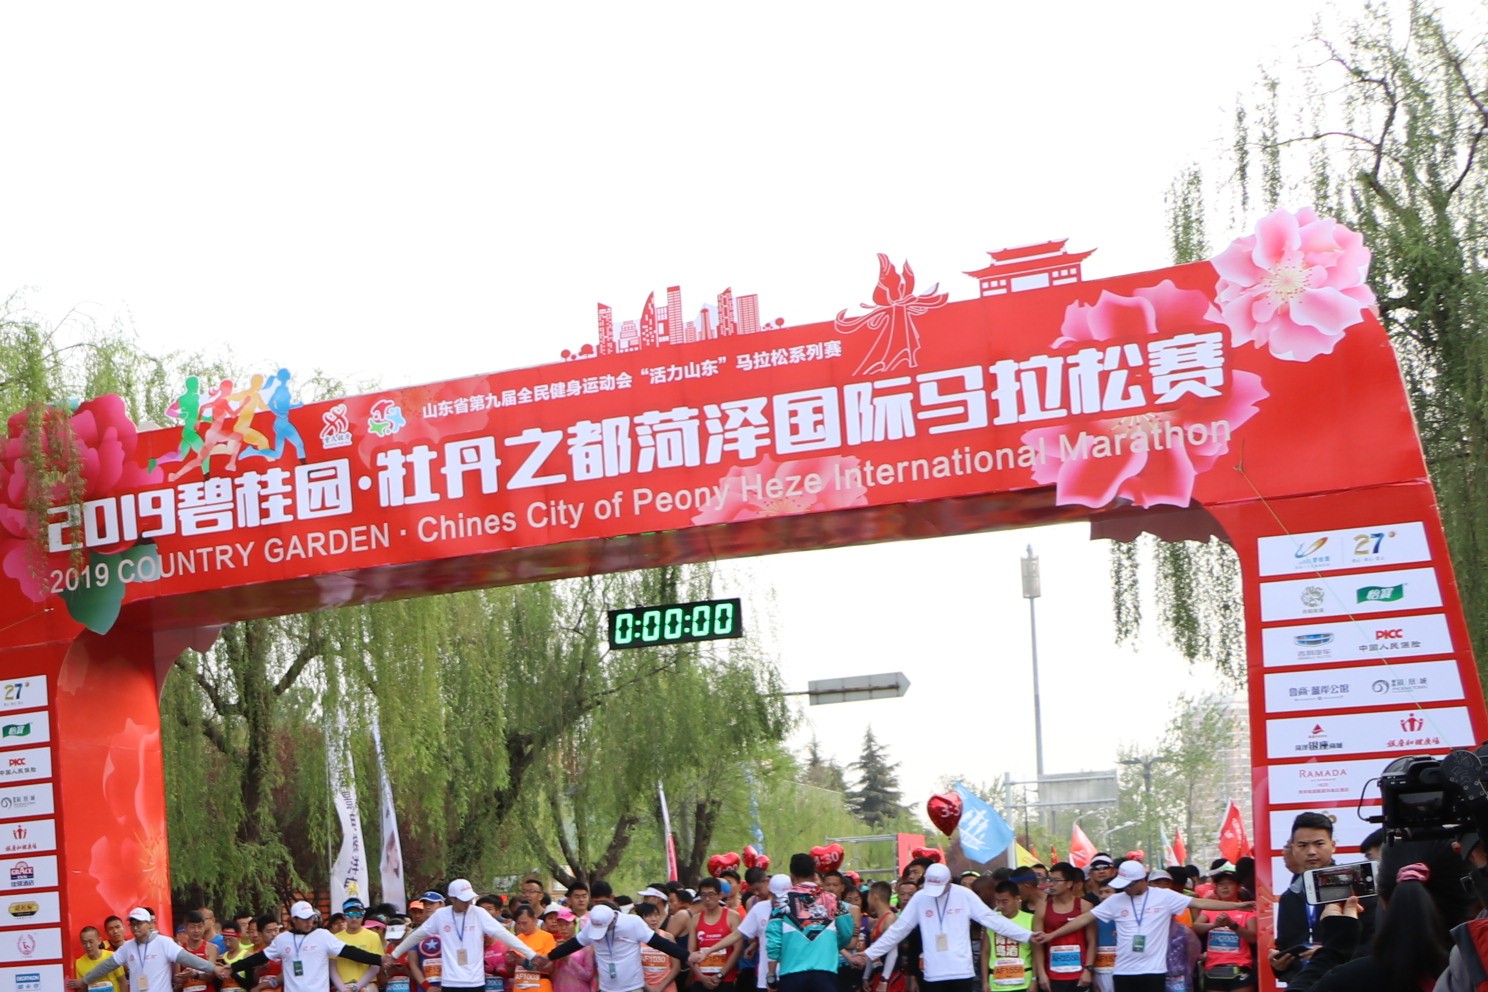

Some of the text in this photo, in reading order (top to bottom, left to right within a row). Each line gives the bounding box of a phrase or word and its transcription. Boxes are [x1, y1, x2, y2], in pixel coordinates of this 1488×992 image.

[422, 372, 632, 419] 山东省第九届全民健身运动会
[736, 340, 842, 371] 马拉松系列赛
[50, 564, 109, 594] 2019
[117, 542, 255, 584] COUNTRY
[264, 523, 389, 563] GARDEN
[417, 509, 516, 542] Chines
[526, 497, 584, 529] City
[594, 491, 623, 520] of
[633, 481, 730, 514] Peony
[741, 470, 823, 501] Heze
[834, 437, 1046, 490] International
[1058, 417, 1230, 463] Marathon
[614, 602, 733, 645] 0:00:00
[1375, 629, 1403, 640] PICC
[1359, 641, 1421, 651] 中国人民保险
[9, 758, 26, 767] PICC
